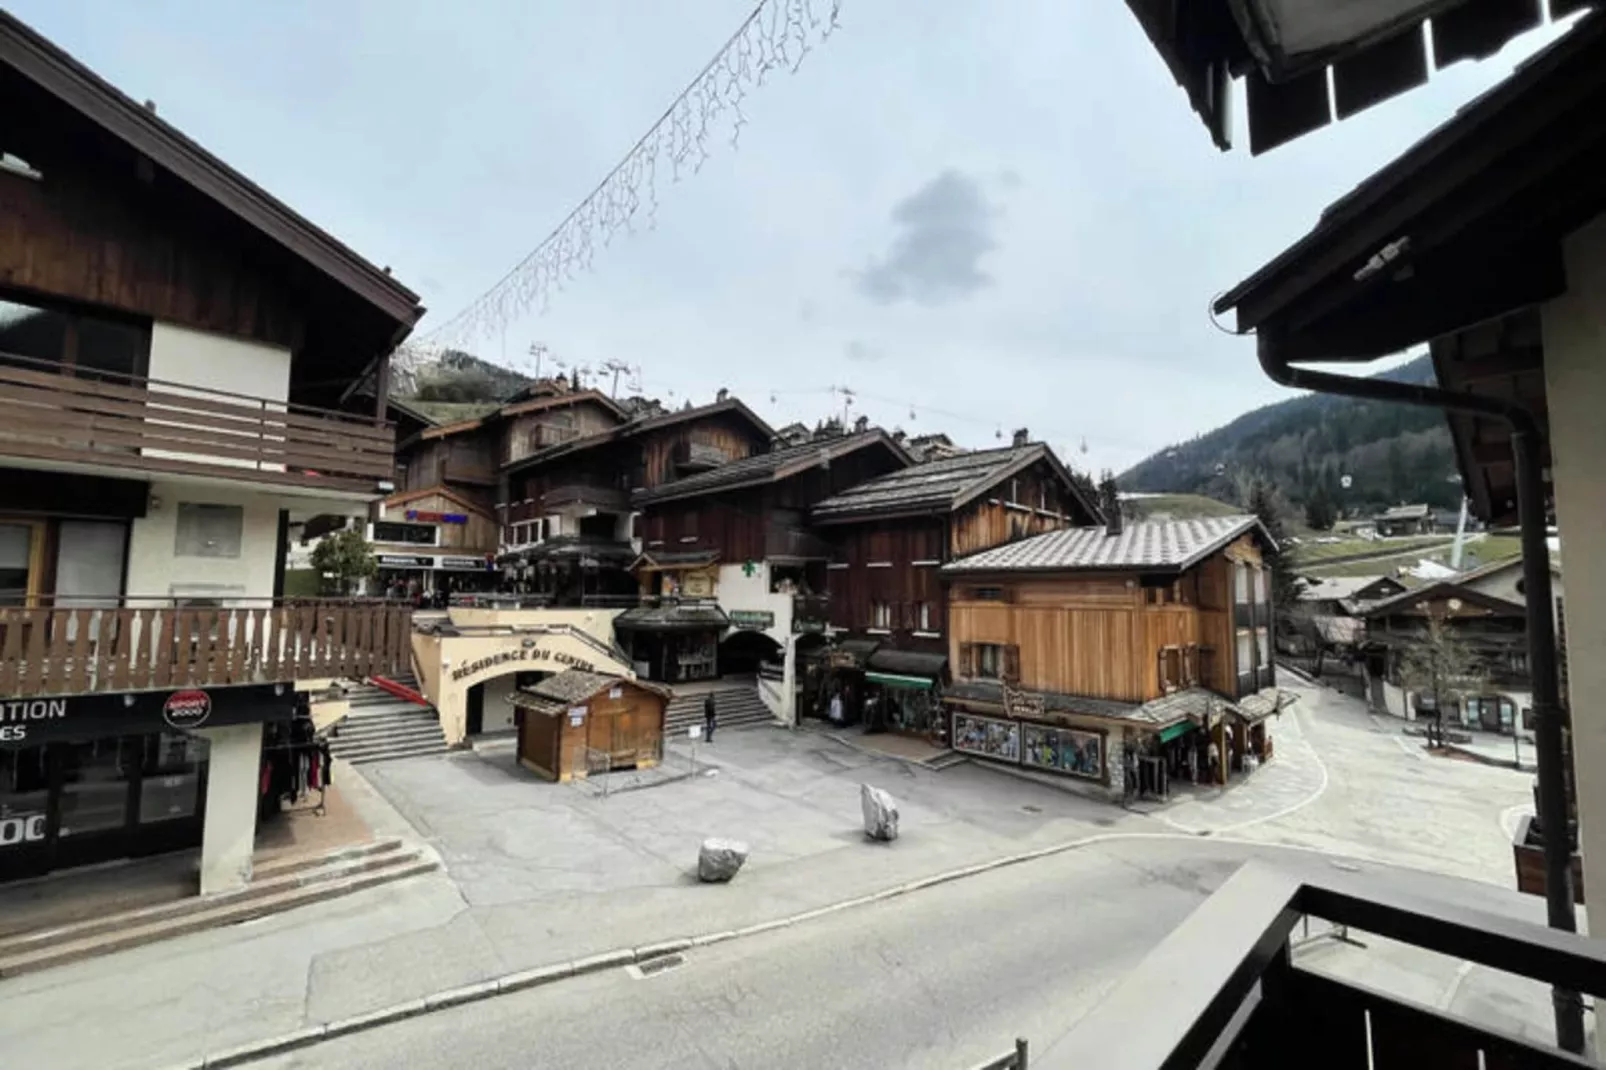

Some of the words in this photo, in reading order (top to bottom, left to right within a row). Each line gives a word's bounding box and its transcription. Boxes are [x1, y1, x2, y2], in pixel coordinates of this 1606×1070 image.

[452, 650, 528, 680] RÉSIDENCE
[532, 648, 551, 660] DU
[554, 652, 594, 672] CENTRE
[168, 698, 207, 709] SPORT
[171, 706, 204, 717] 2000
